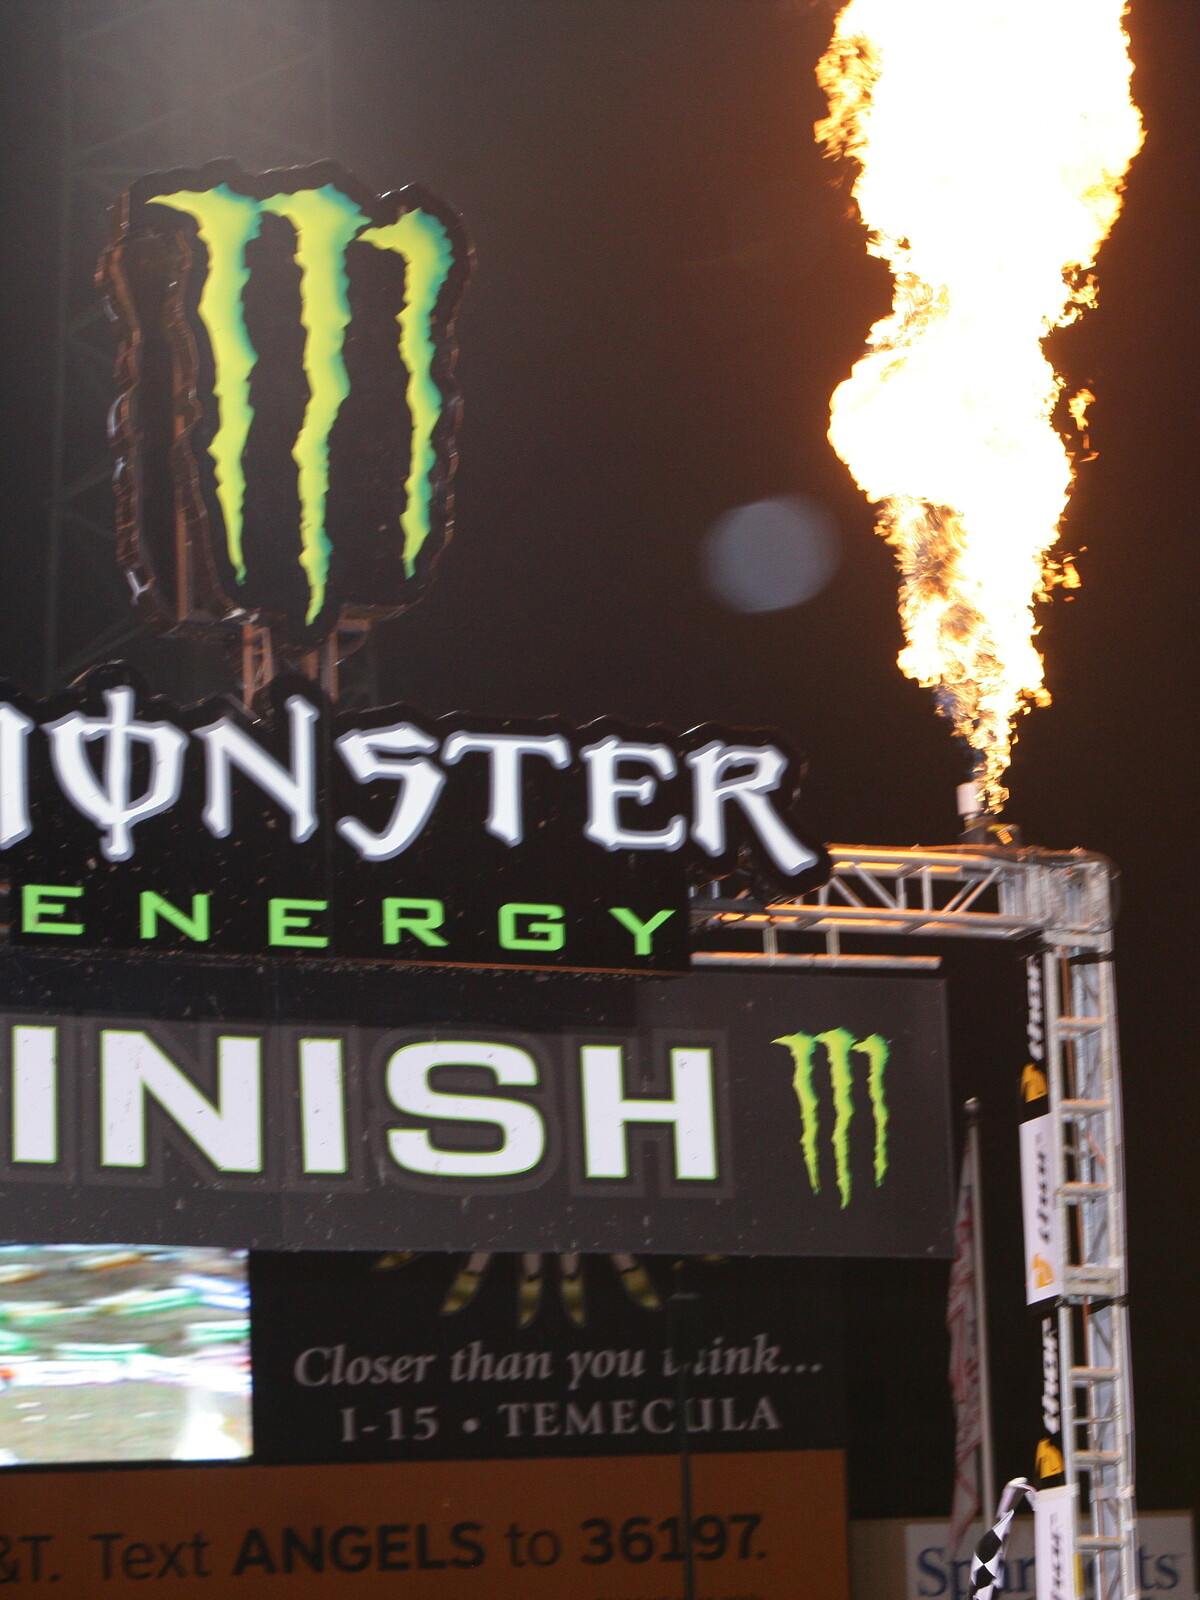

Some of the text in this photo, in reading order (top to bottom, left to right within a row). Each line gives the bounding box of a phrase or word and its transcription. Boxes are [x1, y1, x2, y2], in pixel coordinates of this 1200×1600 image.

[21, 884, 677, 957] ENERGY
[294, 1333, 824, 1391] Closer than you tink...
[340, 1396, 783, 1443] I-15 TEMECULA
[90, 1530, 213, 1582] Text
[231, 1520, 486, 1577] ANGELS
[504, 1521, 562, 1567] to
[580, 1512, 768, 1566] 36197.
